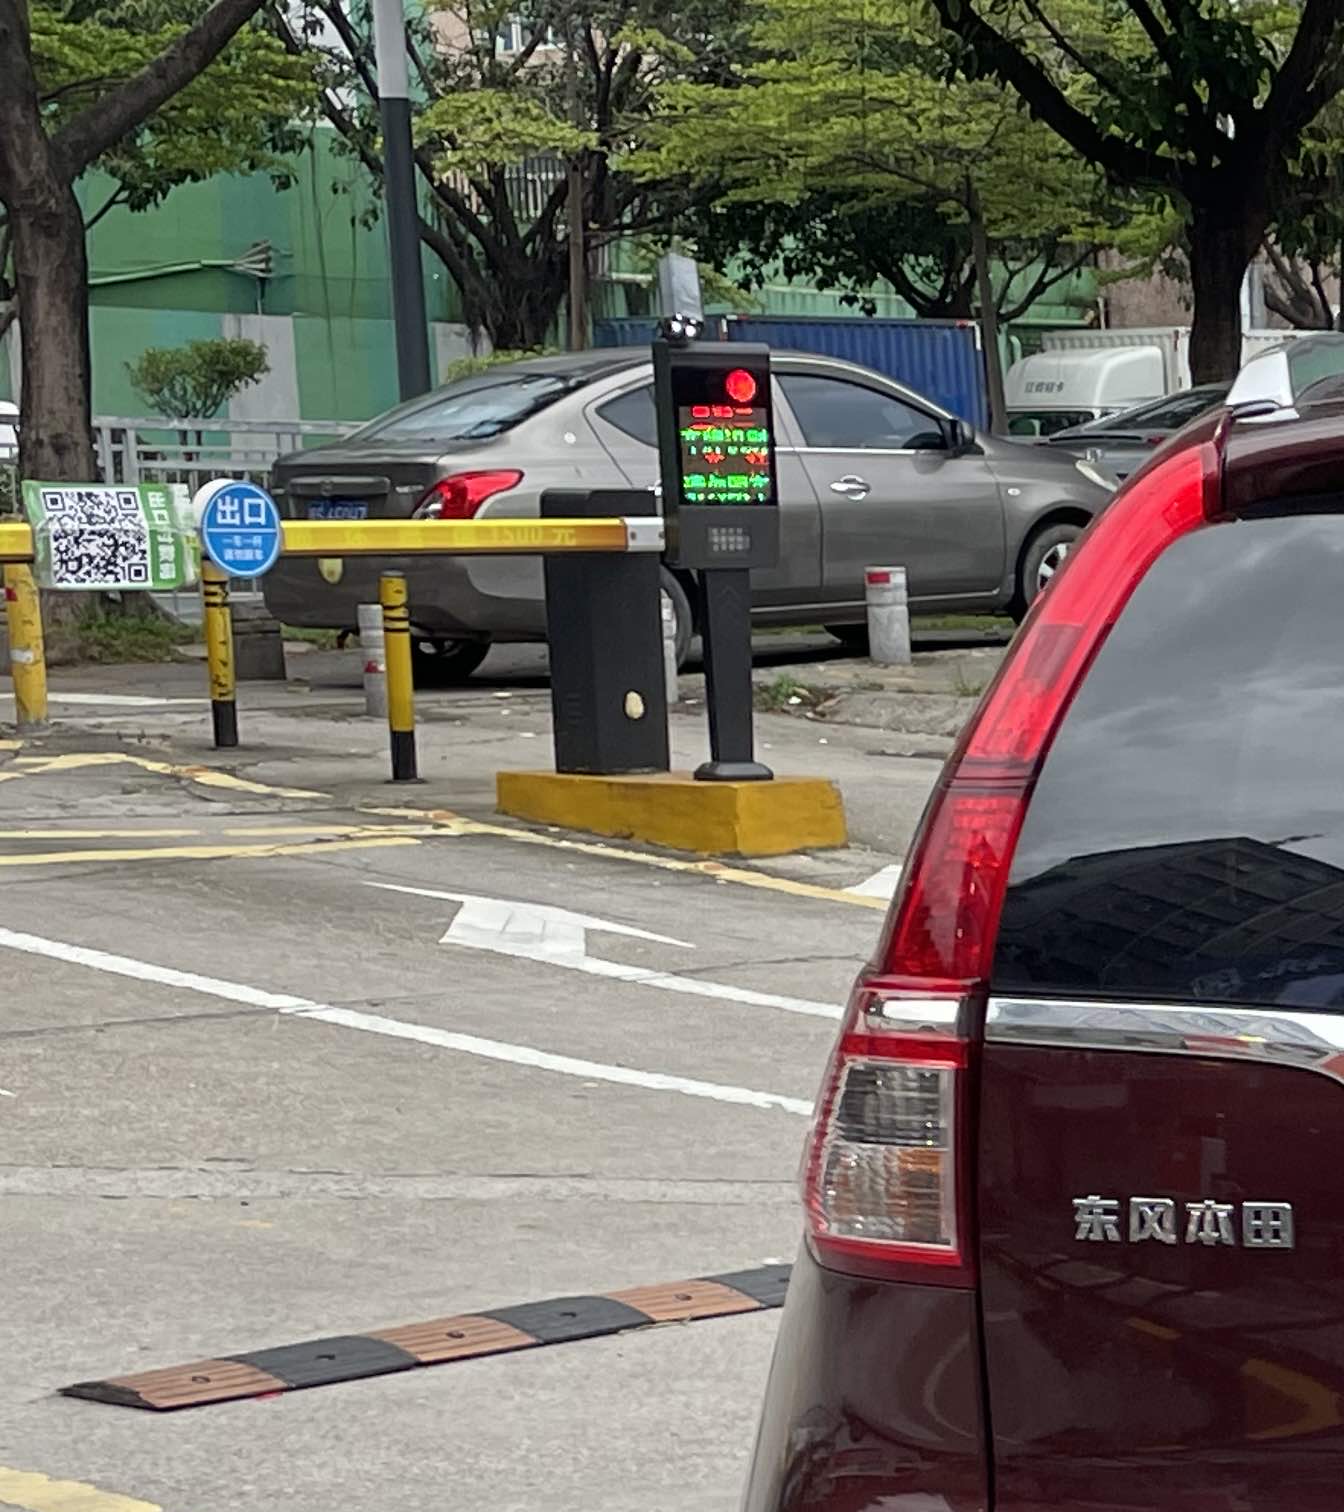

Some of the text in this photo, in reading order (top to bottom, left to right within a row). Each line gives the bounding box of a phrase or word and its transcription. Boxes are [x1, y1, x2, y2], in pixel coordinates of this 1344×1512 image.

[216, 496, 268, 526] 出口
[1072, 1195, 1294, 1249] 东风本田
